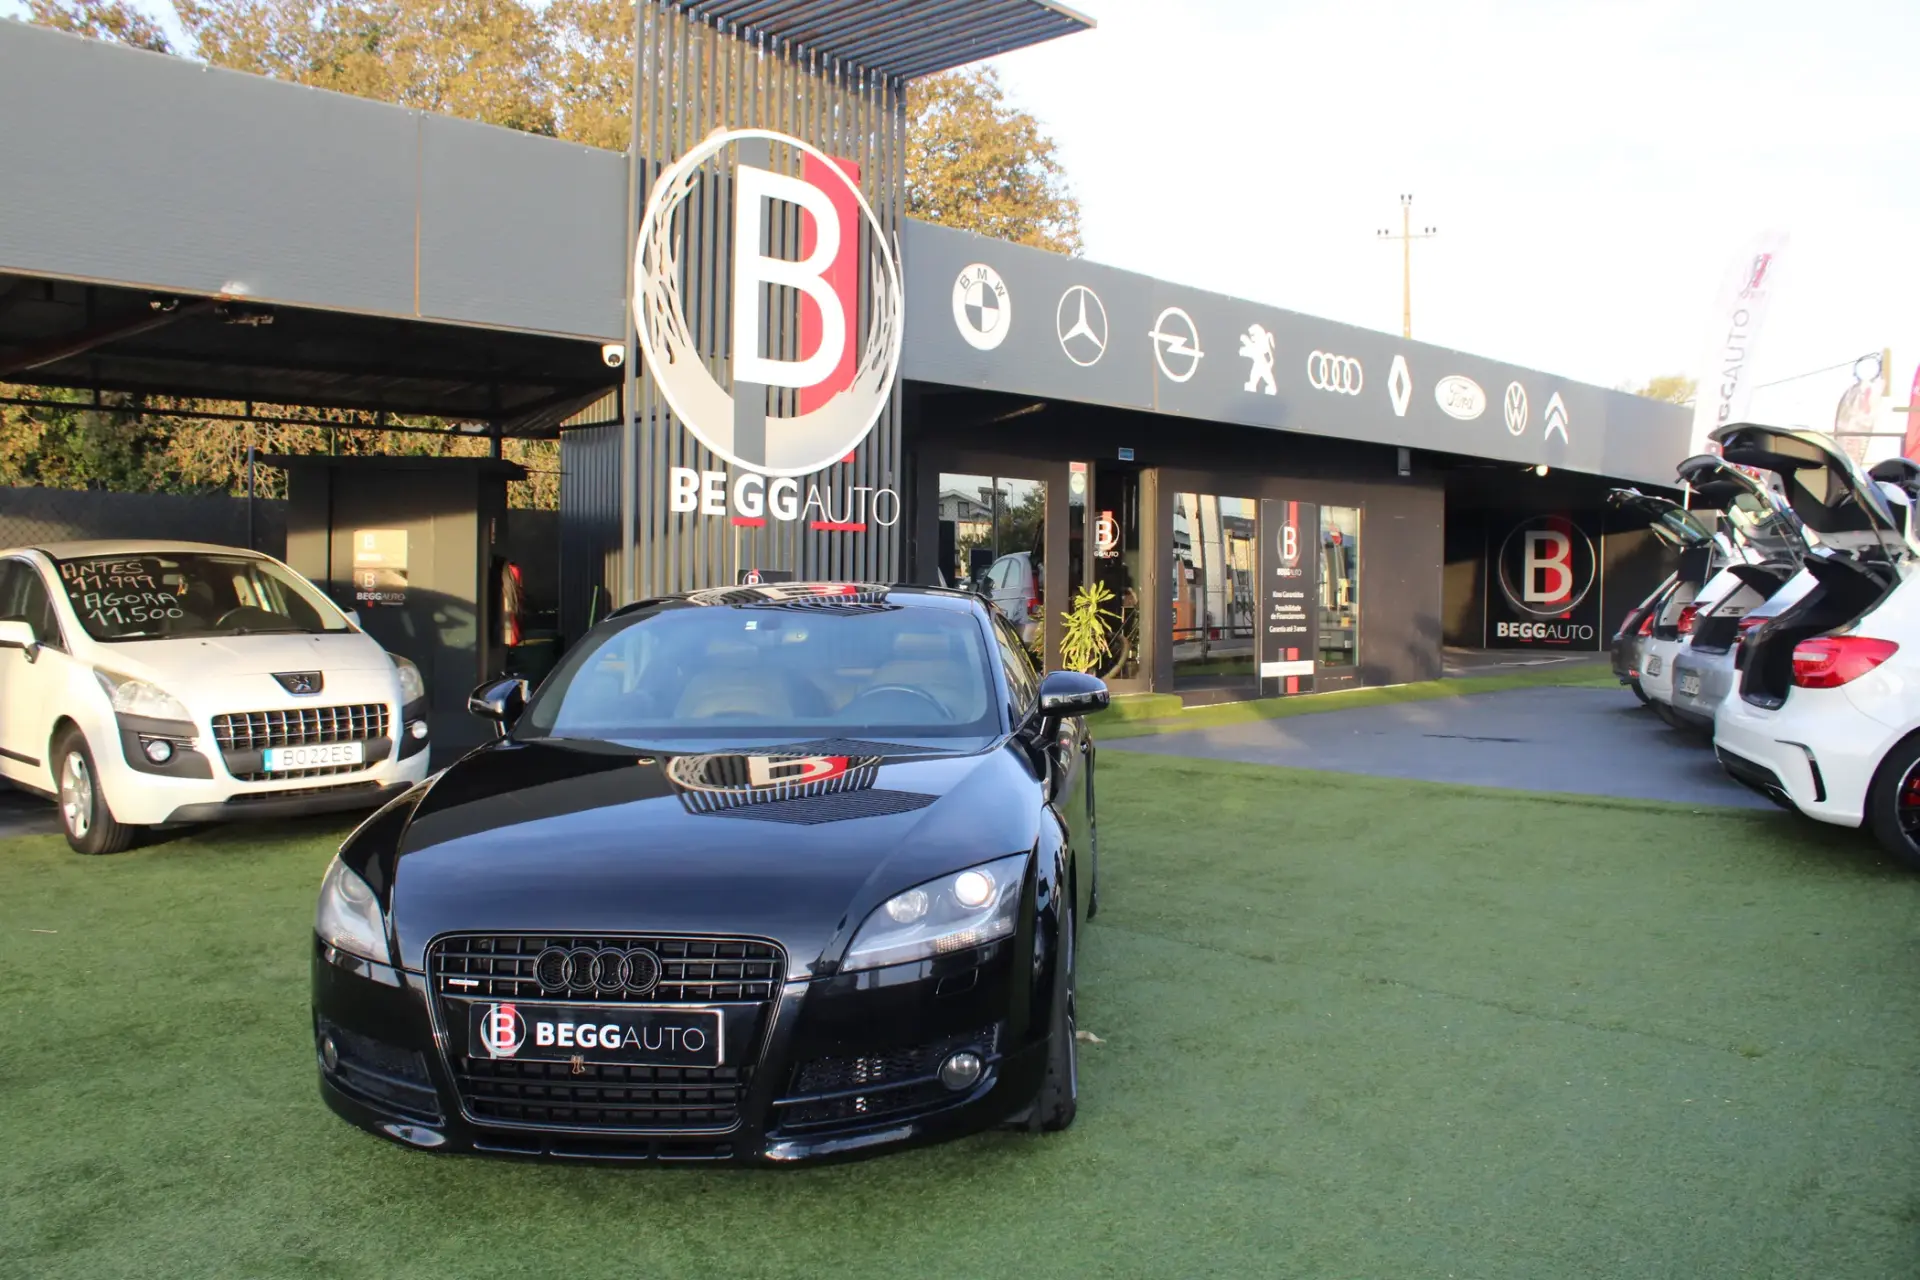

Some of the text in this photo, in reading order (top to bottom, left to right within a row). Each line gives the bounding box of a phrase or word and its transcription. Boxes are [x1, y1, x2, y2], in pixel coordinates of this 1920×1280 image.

[733, 164, 846, 389] B
[960, 267, 1005, 297] BMW
[1718, 309, 1750, 422] GGAUTO
[670, 467, 900, 527] BEGGAUTO
[1096, 520, 1112, 545] B
[1284, 526, 1297, 560] B
[60, 562, 144, 579] ANTES
[1524, 530, 1573, 602] B
[72, 575, 156, 591] 11.999
[356, 592, 405, 601] BEGGAUTO
[84, 593, 177, 610] AGORA
[88, 607, 183, 626] 11.500
[1497, 622, 1594, 640] BEGGAUTO
[491, 1013, 706, 1051] B BEGGAUTO
